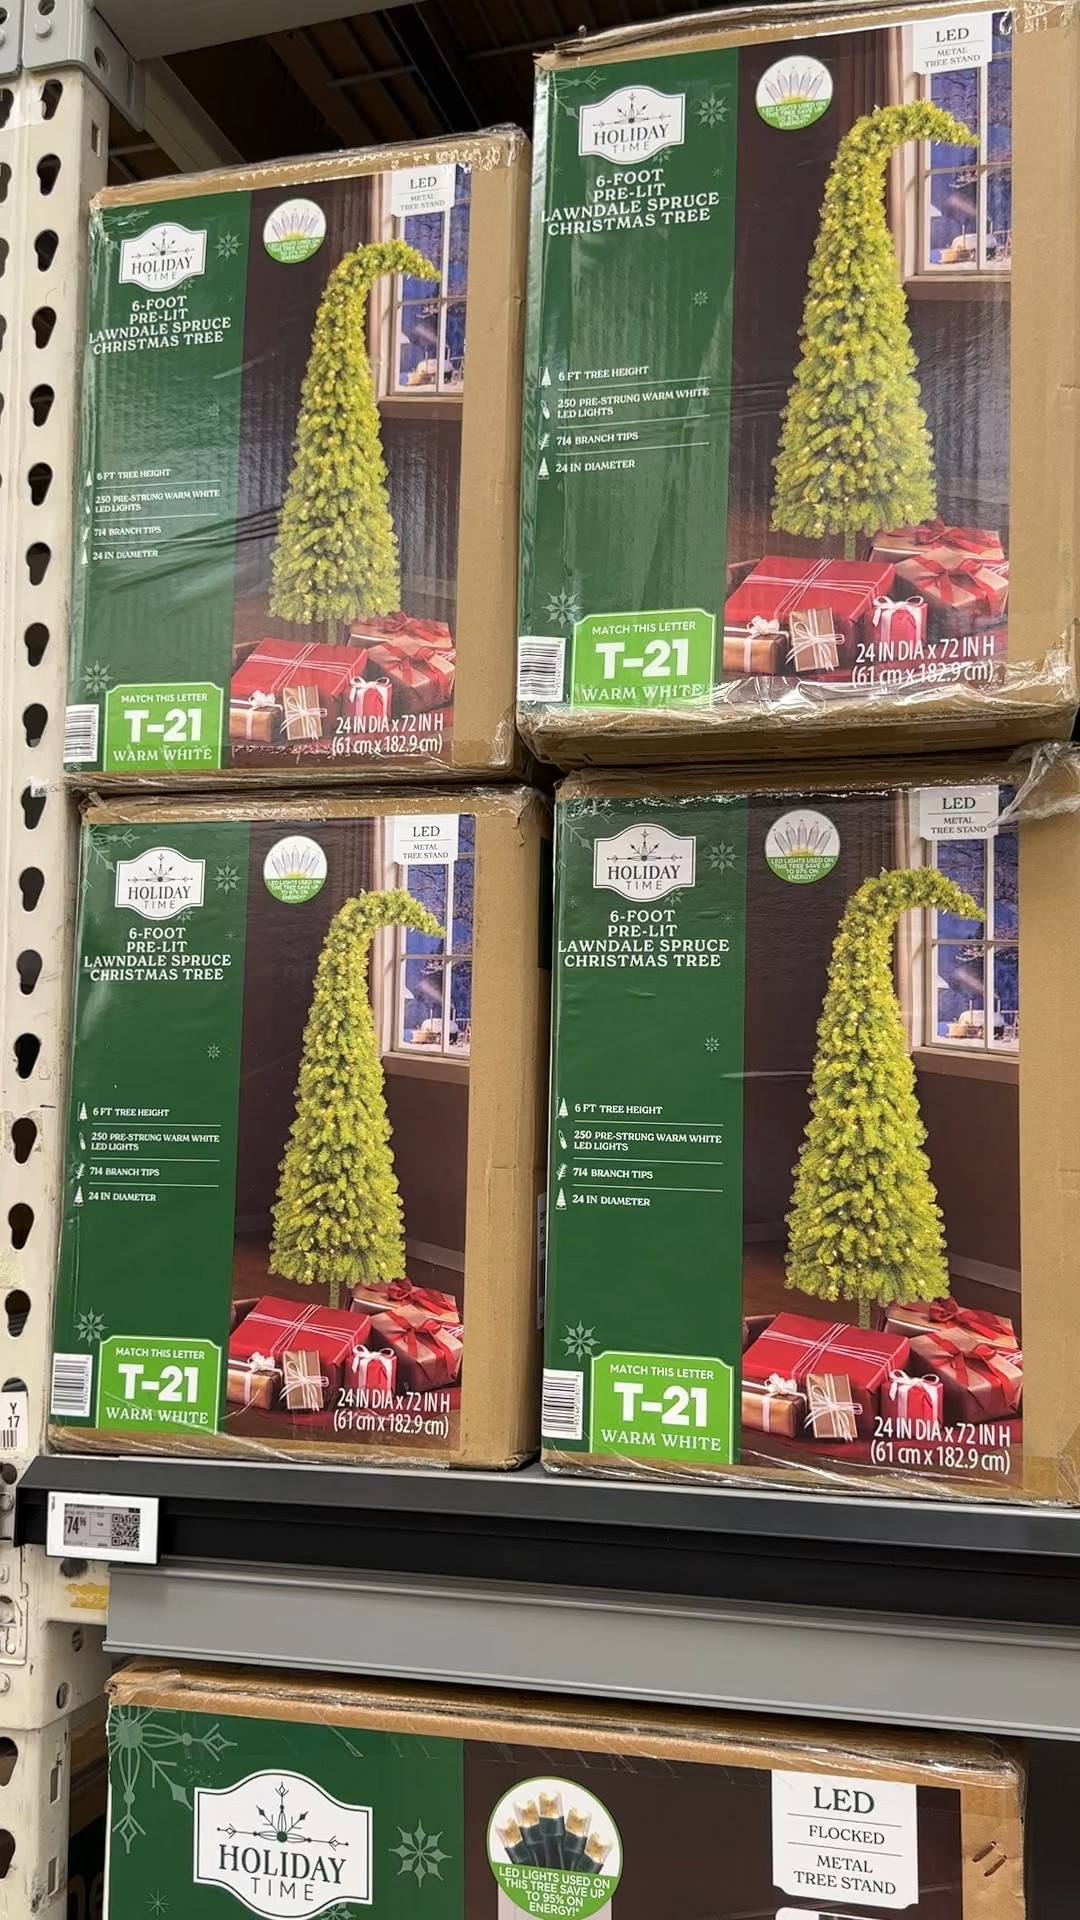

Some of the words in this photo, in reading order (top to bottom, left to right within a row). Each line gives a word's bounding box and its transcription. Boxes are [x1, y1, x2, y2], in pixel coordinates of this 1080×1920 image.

[936, 28, 969, 43] LED
[937, 48, 968, 57] METAL
[924, 59, 948, 68] TREE
[950, 55, 980, 65] STAND
[594, 124, 669, 145] HOLIDAY
[613, 141, 650, 153] TIME
[410, 177, 437, 189] LED
[596, 169, 664, 187] 6-FOOT
[593, 184, 666, 202] PRE-LIT
[541, 201, 642, 223] LAWNDALE
[647, 192, 719, 211] SPRUCE
[548, 214, 656, 236] CHRISTMAS
[661, 208, 710, 225] TREE
[132, 256, 192, 275] HOLIDAY
[147, 272, 177, 282] TIME
[132, 296, 187, 311] 6-FOOT
[130, 309, 188, 324] PRE-LIT
[89, 323, 168, 344] LAWNDALE
[173, 317, 231, 333] SPRUCE
[93, 336, 179, 355] CHRISTMAS
[184, 331, 223, 345] TREE
[592, 625, 629, 635] MATCH
[633, 623, 656, 633] THIS
[659, 621, 696, 632] LETTER
[856, 643, 875, 663] 24
[879, 641, 893, 662] IN
[899, 640, 924, 661] DIA
[928, 644, 936, 659] x
[940, 639, 958, 658] 72
[963, 637, 978, 657] IN
[983, 636, 994, 655] H
[596, 639, 688, 679] T-21
[122, 695, 153, 703] MATCH
[156, 694, 175, 702] THIS
[177, 693, 207, 701] LETTER
[582, 687, 636, 701] WARM
[643, 684, 703, 698] WHITE
[124, 708, 201, 743] T-21
[113, 750, 158, 761] WARM
[163, 748, 212, 760] WHITE
[942, 797, 976, 810] LED
[944, 816, 974, 824] METAL
[413, 826, 440, 837] LED
[608, 865, 680, 880] HOLIDAY
[626, 881, 662, 890] TIME
[128, 886, 191, 899] HOLIDAY
[144, 900, 175, 909] TIME
[610, 910, 675, 922] 6-FOOT
[129, 928, 186, 939] 6-FOOT
[608, 925, 678, 937] PRE-LIT
[127, 942, 187, 953] PRE-LIT
[559, 940, 654, 952] LAWNDALE
[660, 939, 730, 952] SPRUCE
[84, 956, 166, 967] LAWNDALE
[172, 955, 231, 966] SPRUCE
[565, 955, 668, 967] CHRISTMAS
[673, 955, 721, 967] TREE
[90, 969, 178, 981] CHRISTMAS
[183, 969, 223, 980] TREE
[138, 1109, 170, 1117] HEIGHT
[575, 1104, 581, 1112] 6
[583, 1104, 596, 1112] FT
[599, 1105, 624, 1113] TREE
[626, 1105, 663, 1115] HEIGHT
[110, 1133, 161, 1141] PRE-STRUNG
[191, 1135, 220, 1143] WHITE
[574, 1131, 592, 1139] 250
[595, 1132, 654, 1141] PRE-STRUNG
[656, 1134, 686, 1142] WARM
[689, 1135, 722, 1143] WHITE
[109, 1143, 139, 1151] LIGHTS
[574, 1142, 592, 1150] LED
[594, 1143, 628, 1151] LIGHTS
[90, 1167, 102, 1175] 714
[573, 1168, 588, 1176] 714
[591, 1169, 629, 1178] BRANCH
[631, 1170, 653, 1179] TIPS
[88, 1192, 98, 1200] 24
[101, 1192, 110, 1200] IN
[113, 1193, 156, 1201] DIAMETER
[573, 1194, 584, 1203] 24
[587, 1195, 597, 1204] IN
[601, 1196, 650, 1206] DIAMETER
[116, 1348, 149, 1357] MATCH
[151, 1349, 171, 1358] THIS
[173, 1350, 205, 1359] LETTER
[610, 1364, 648, 1375] MATCH
[651, 1366, 674, 1376] THIS
[677, 1368, 714, 1380] LETTER
[118, 1364, 198, 1403] T-21
[338, 1388, 354, 1407] 24
[356, 1389, 369, 1408] IN
[372, 1390, 393, 1409] DIA
[396, 1396, 403, 1410] x
[406, 1392, 421, 1411] 72
[424, 1392, 437, 1412] IN
[441, 1394, 450, 1413] H
[614, 1382, 707, 1427] T-21
[10, 1402, 17, 1414] Y
[8, 1416, 20, 1428] 17
[106, 1407, 152, 1421] WARM
[158, 1410, 208, 1424] WHITE
[874, 1416, 893, 1437] 24
[897, 1418, 911, 1439] IN
[916, 1419, 941, 1441] DIA
[945, 1426, 953, 1442] x
[957, 1423, 975, 1444] 72
[979, 1424, 995, 1446] IN
[1000, 1426, 1010, 1447] H
[601, 1429, 656, 1445] WARM
[662, 1434, 721, 1451] WHITE
[871, 1440, 892, 1464] (61
[898, 1447, 920, 1464] cm
[924, 1449, 932, 1465] x
[937, 1446, 978, 1469] 182.9
[981, 1450, 1010, 1475] cm)
[813, 1786, 875, 1813] LED
[809, 1825, 885, 1845] FLOCKED
[219, 1844, 346, 1884] HOLIDAY
[817, 1855, 873, 1873] METAL
[499, 1867, 519, 1878] LED
[522, 1869, 559, 1882] LIGHTS
[562, 1875, 590, 1886] USED
[593, 1878, 610, 1889] ON
[793, 1871, 837, 1888] TREE
[841, 1877, 896, 1894] STAND
[251, 1877, 314, 1901] TIME
[505, 1878, 527, 1889] THIS
[531, 1881, 556, 1893] TREE
[560, 1885, 587, 1897] SAVE
[591, 1889, 605, 1899] UP
[526, 1891, 540, 1901] TO
[543, 1894, 564, 1904] 95%
[567, 1897, 583, 1907] ON
